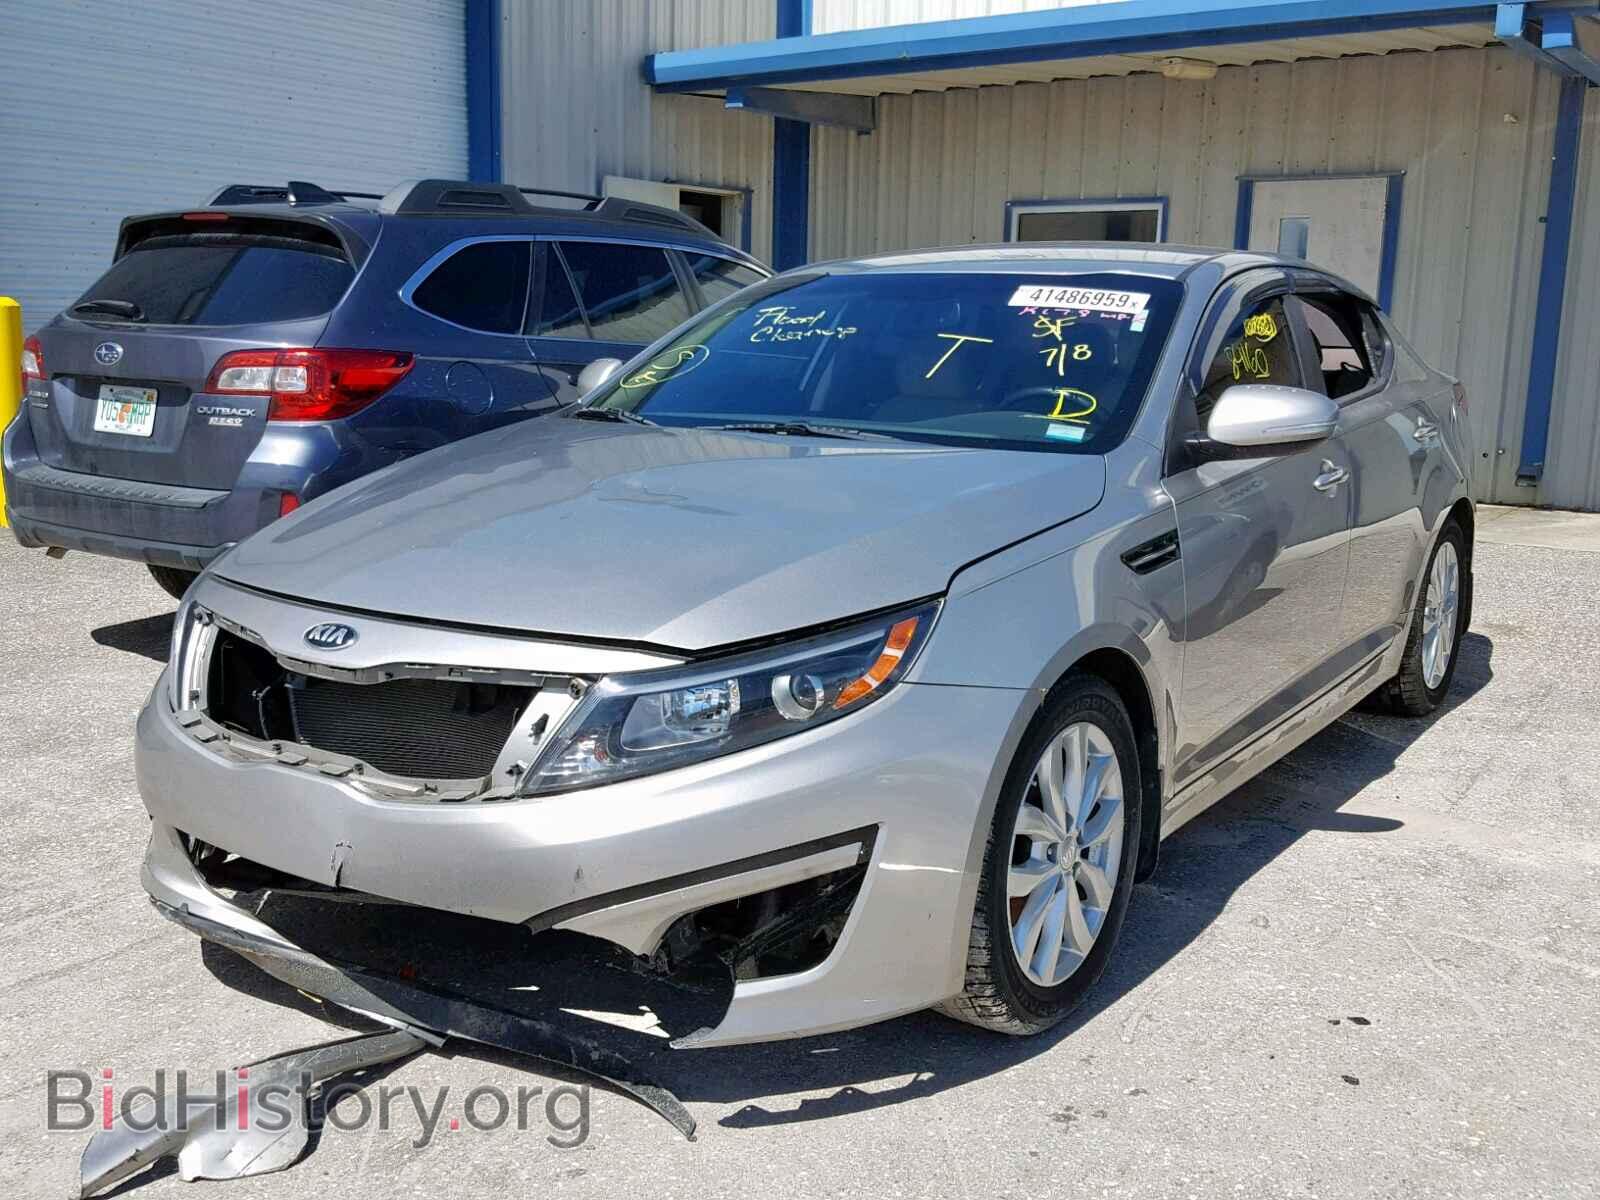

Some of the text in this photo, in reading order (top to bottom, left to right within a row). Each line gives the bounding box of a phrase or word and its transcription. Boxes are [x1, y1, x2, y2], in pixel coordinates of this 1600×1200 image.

[925, 333, 994, 379] T
[196, 406, 257, 416] OUTBACK
[1048, 388, 1098, 420] D
[307, 625, 348, 645] KIA
